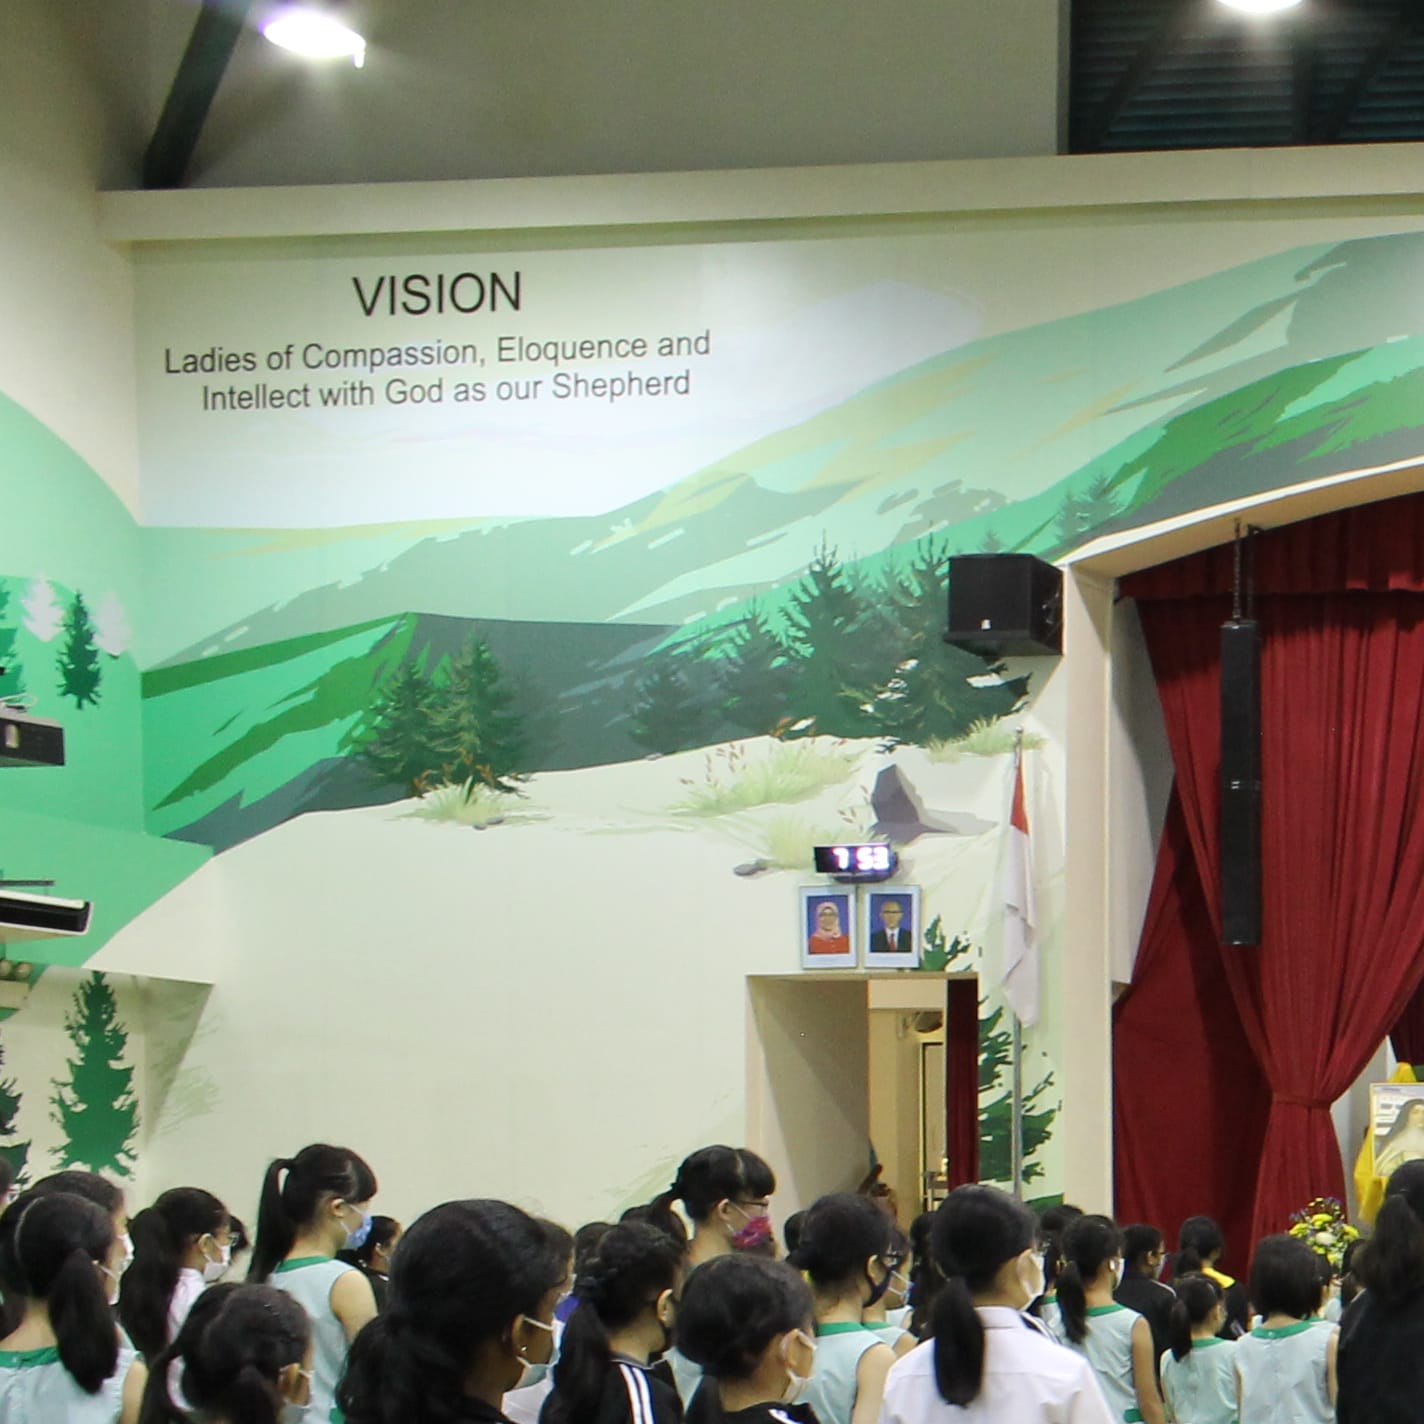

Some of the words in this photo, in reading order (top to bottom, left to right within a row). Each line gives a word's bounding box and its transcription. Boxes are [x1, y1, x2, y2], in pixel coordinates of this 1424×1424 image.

[352, 271, 520, 316] VISION
[165, 347, 256, 373] Ladies
[267, 344, 294, 370] of
[302, 340, 484, 373] Compassion,
[498, 336, 647, 366] Eloquence
[658, 330, 709, 356] and
[203, 384, 309, 410] Intellect
[319, 380, 373, 406] with
[385, 378, 442, 404] God
[454, 382, 486, 402] as
[497, 380, 543, 400] our
[552, 369, 690, 402] Shepherd
